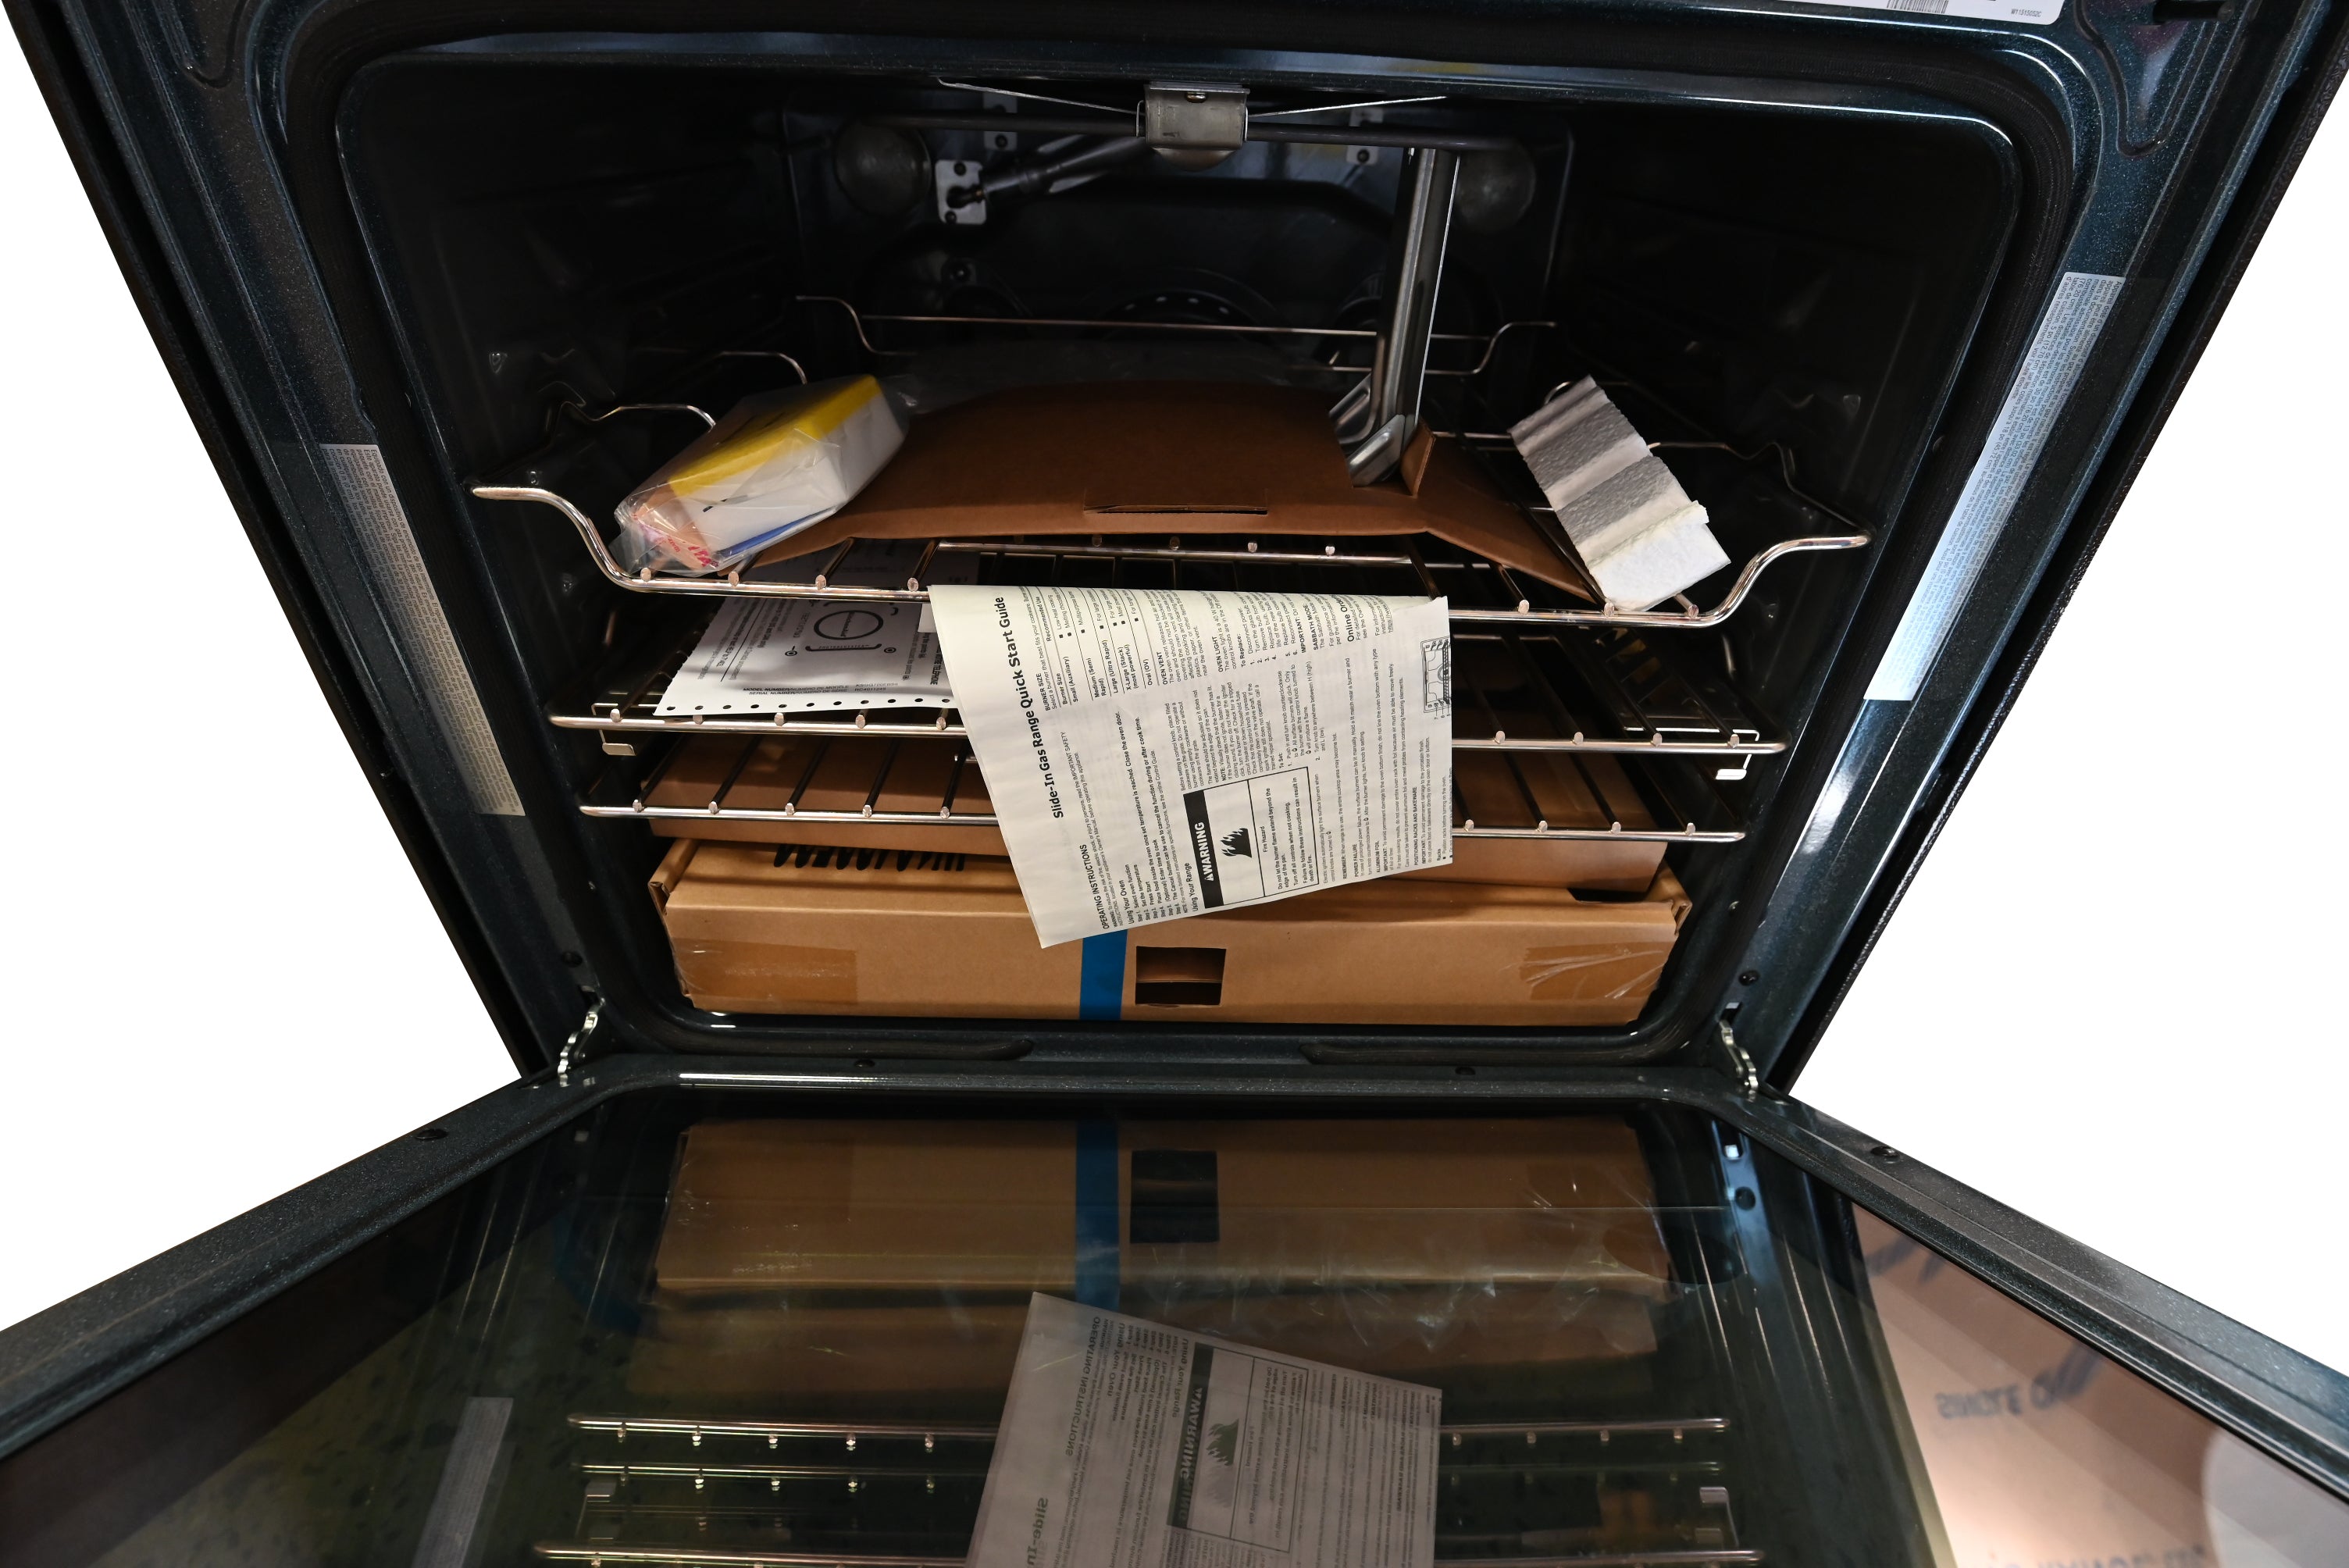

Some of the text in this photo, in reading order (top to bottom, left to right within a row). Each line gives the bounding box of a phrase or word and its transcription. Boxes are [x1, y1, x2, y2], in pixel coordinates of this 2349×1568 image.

[1037, 604, 1052, 642] Recommended
[1345, 614, 1355, 642] Online
[1211, 636, 1221, 655] LIGHT
[1309, 621, 1319, 650] SABBATH
[1102, 640, 1110, 660] Rapid)
[1156, 651, 1164, 668] VENT
[1107, 661, 1116, 677] (Ultra
[1117, 647, 1132, 690] X-Large (Stack)
[1124, 644, 1139, 689] (most powerful)
[1142, 658, 1151, 672] (OV)
[1043, 672, 1052, 690] burner
[1063, 656, 1078, 703] Small (Auxiliary)
[1085, 657, 1100, 698] Medium (Semi
[1098, 678, 1107, 697] Rapid)
[1035, 673, 1051, 711] BURNER SIZE
[1049, 694, 1057, 710] Select
[1059, 686, 1068, 705] Burner
[994, 597, 1064, 818] Slide-In Gas Range Quick Start Guide
[1127, 768, 1136, 790] reached.
[1135, 796, 1145, 826] temperature
[1266, 796, 1274, 815] beyond
[1194, 822, 1213, 875] WARNING
[1125, 864, 1133, 883] function
[1133, 864, 1143, 892] temperature
[1184, 863, 1192, 882] Range
[1079, 844, 1110, 929] OPERATING INSTRUCTIONS
[1161, 880, 1171, 902] (Optional)
